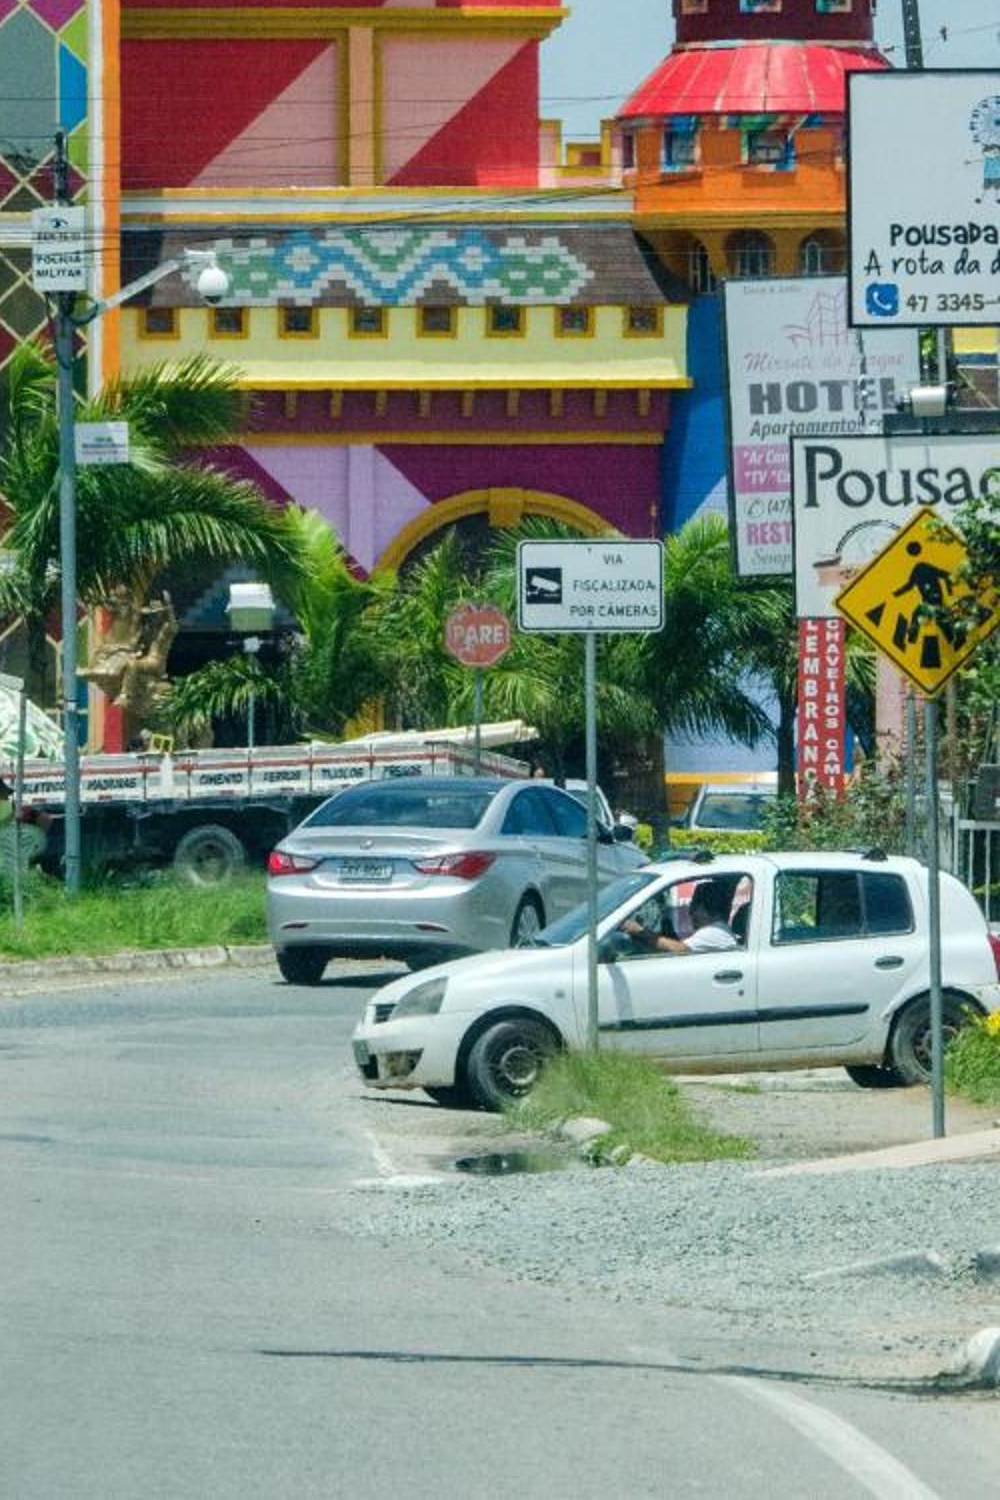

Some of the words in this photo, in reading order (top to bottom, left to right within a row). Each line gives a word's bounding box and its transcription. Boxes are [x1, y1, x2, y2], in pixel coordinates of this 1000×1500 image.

[863, 248, 883, 277] A
[892, 248, 945, 276] rota
[953, 247, 981, 276] da
[906, 294, 929, 313] 47
[749, 377, 897, 415] HOTEL
[603, 554, 623, 565] VIA
[573, 579, 656, 592] FISCALIZADA
[570, 605, 595, 617] POR
[452, 624, 505, 645] PARE
[824, 619, 840, 729] CHAVEIROS
